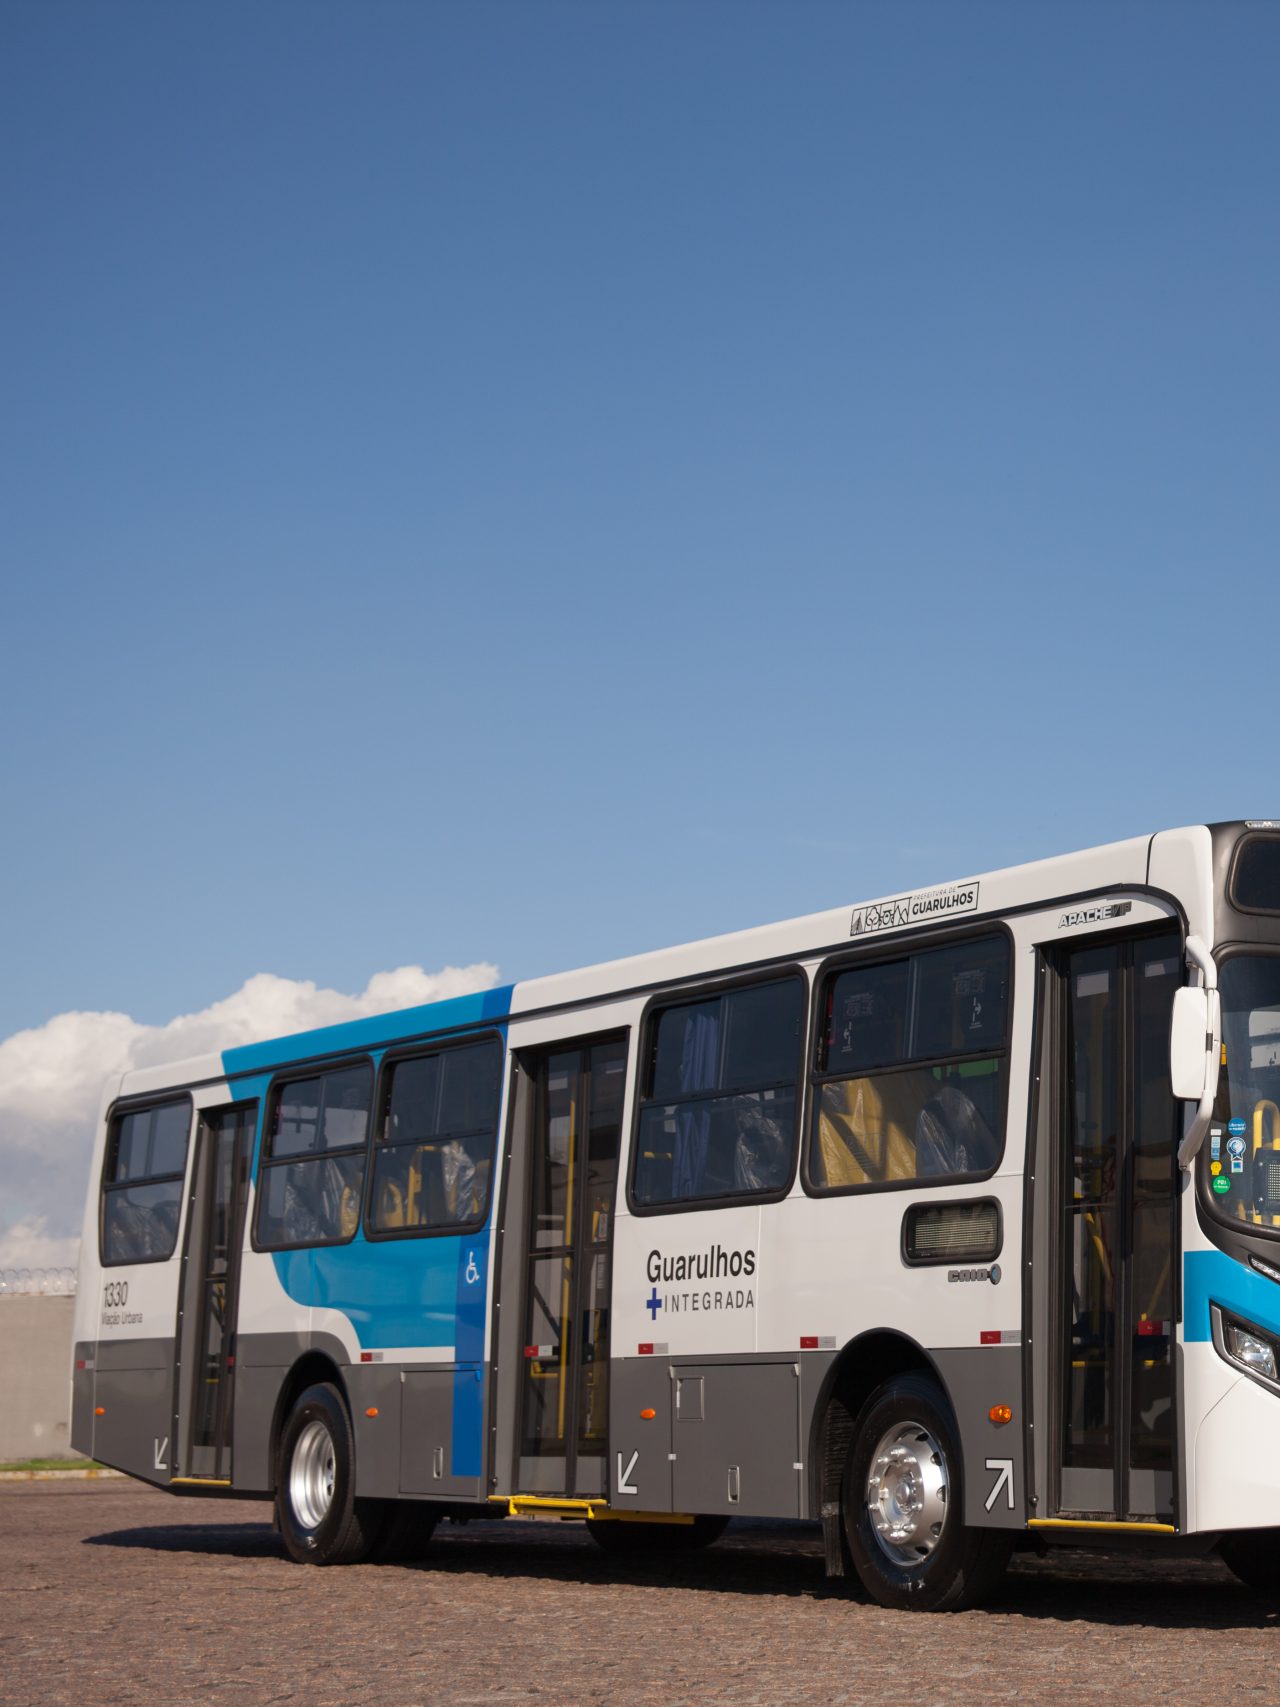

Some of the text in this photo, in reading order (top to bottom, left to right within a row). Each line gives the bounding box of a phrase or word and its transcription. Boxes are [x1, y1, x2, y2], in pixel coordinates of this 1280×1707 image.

[912, 891, 974, 915] GUARULHOS
[1058, 906, 1111, 929] APACHE
[646, 1244, 756, 1283] Guarulhos
[104, 1281, 129, 1308] 1330
